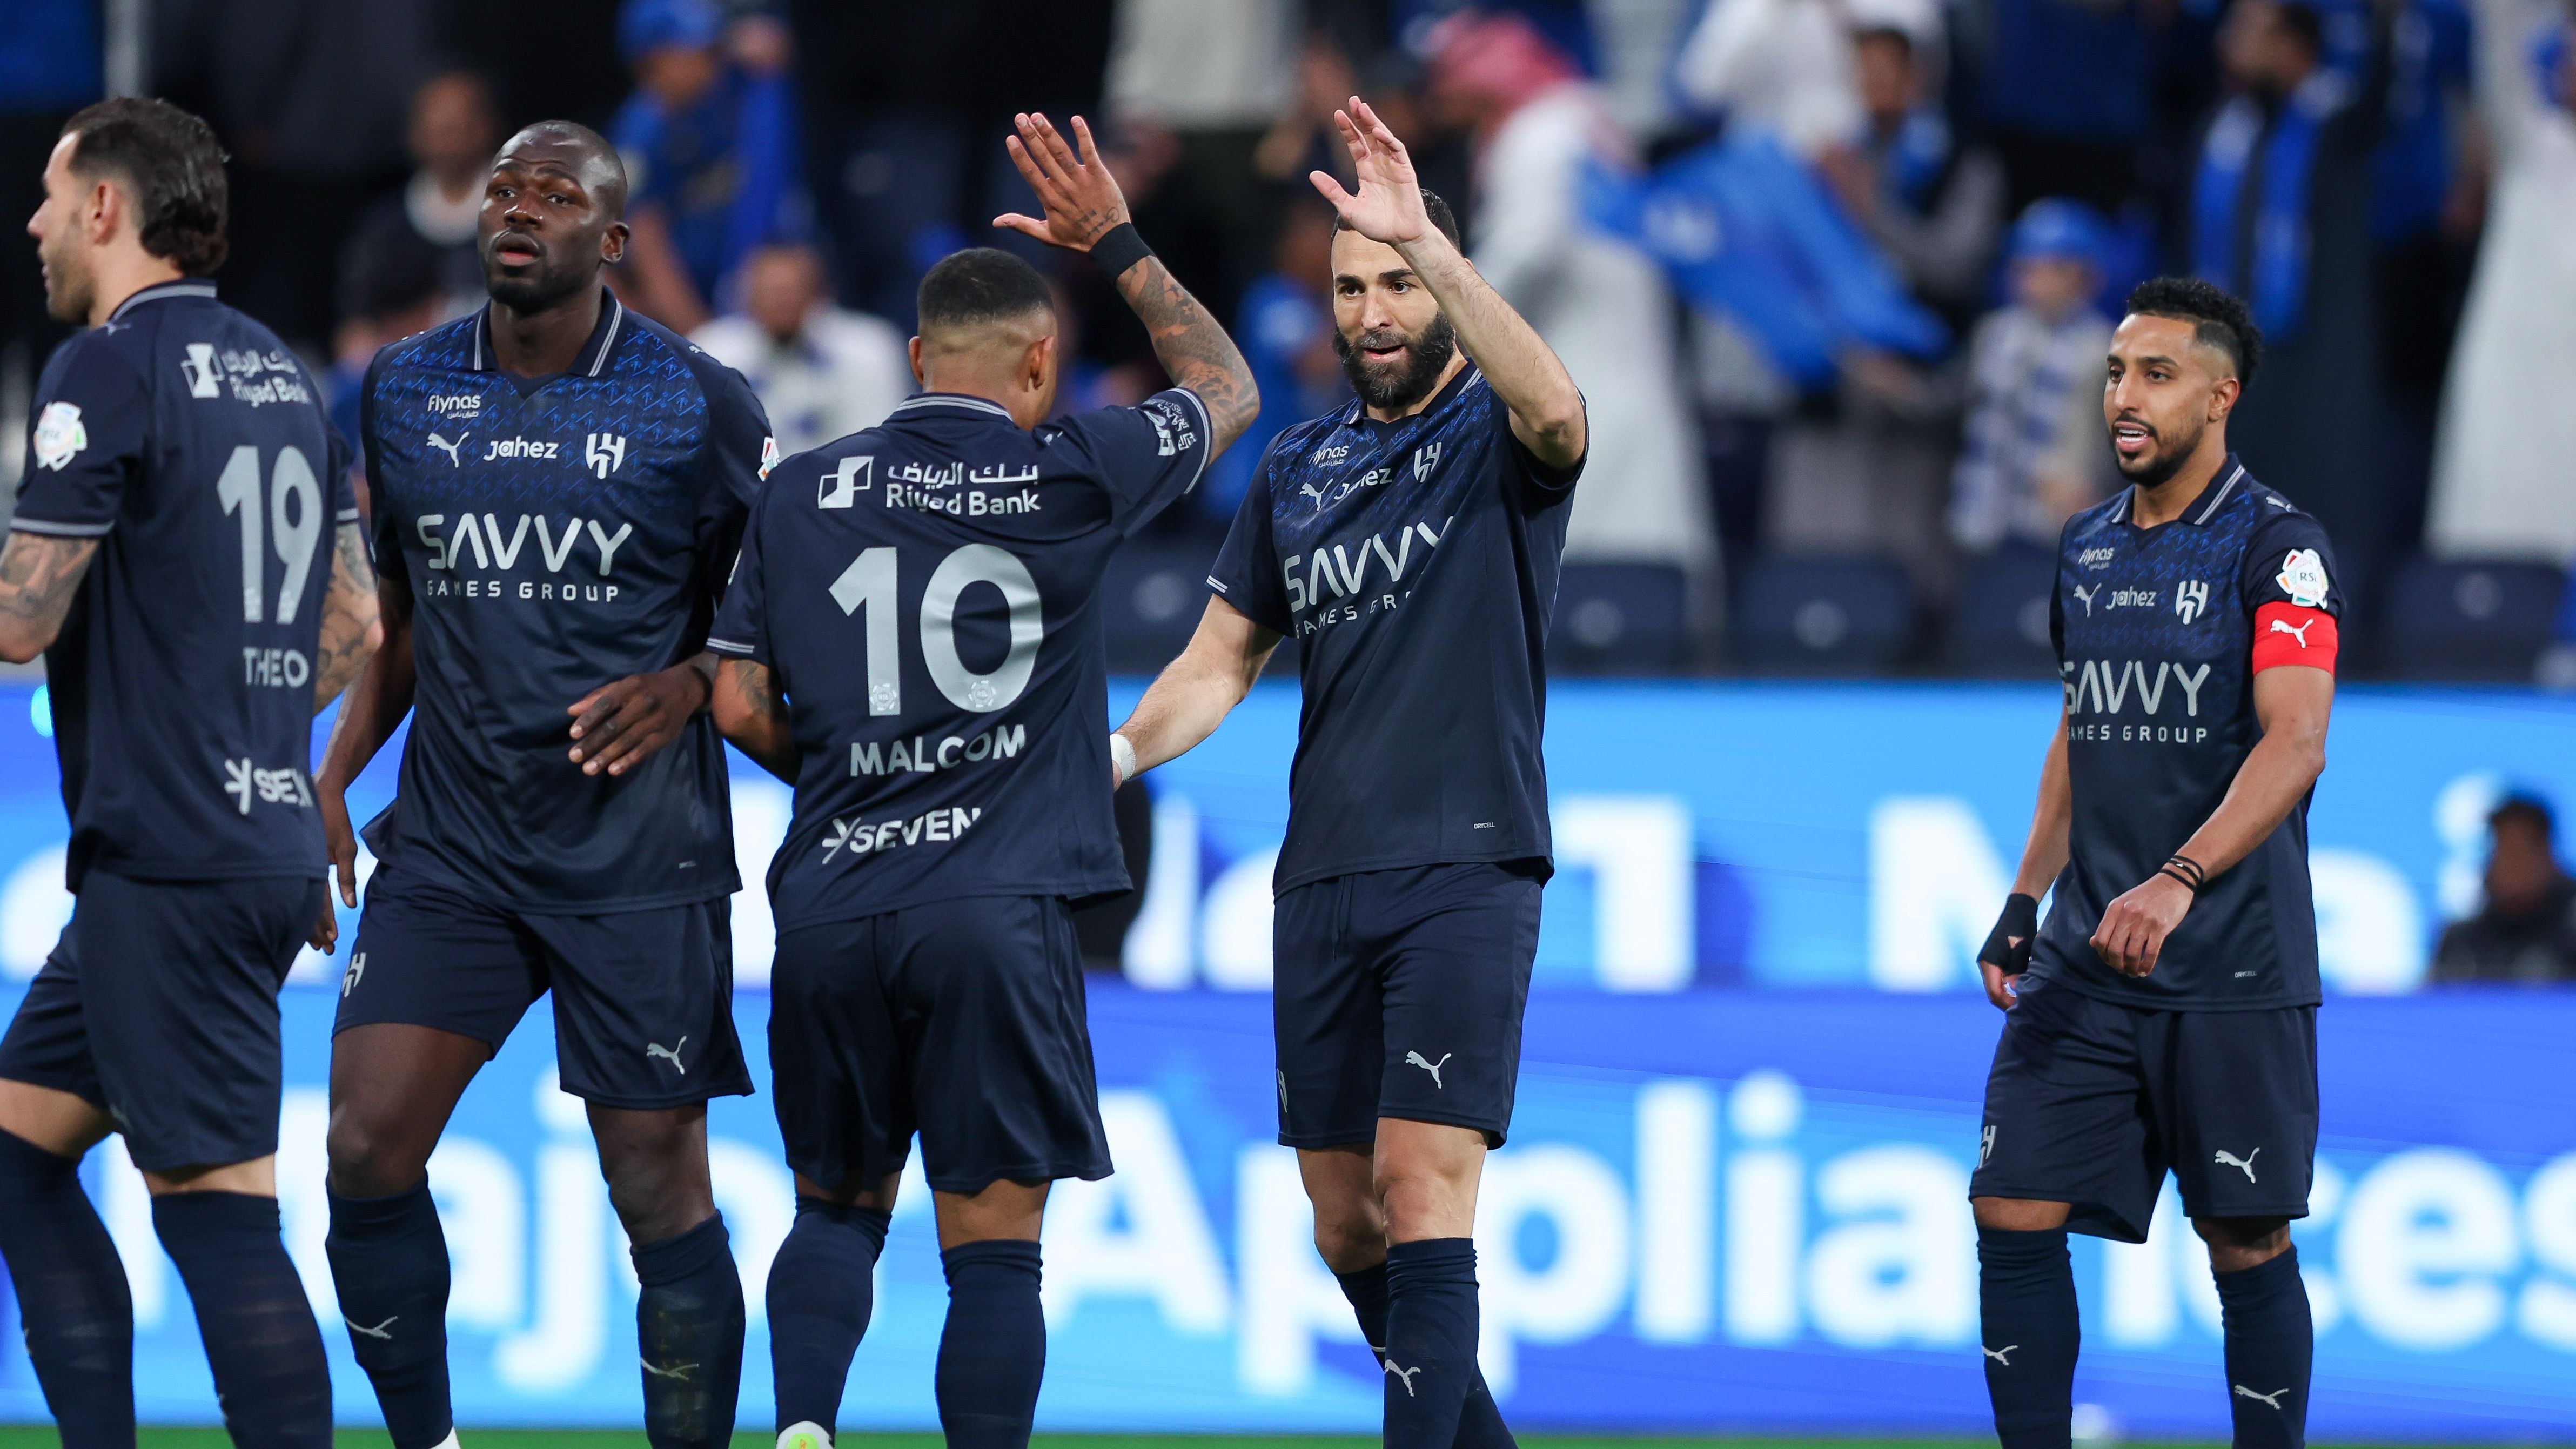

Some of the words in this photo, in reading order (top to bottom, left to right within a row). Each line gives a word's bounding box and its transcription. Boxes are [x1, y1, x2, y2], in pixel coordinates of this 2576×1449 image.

[427, 394, 481, 414] flynas
[887, 461, 963, 489] الرياض
[969, 462, 1039, 485] بنك
[886, 483, 962, 514] Riyad
[969, 489, 1041, 516] Bank
[217, 446, 323, 624] 19
[417, 512, 633, 576] SAVVY
[427, 579, 501, 598] GAMES
[518, 581, 619, 602] GROUP
[828, 543, 1044, 717] 10
[243, 647, 309, 688] THEO
[2060, 660, 2211, 717] SAVVY
[850, 724, 1026, 777] MALCOM
[2123, 725, 2208, 744] GROUP
[849, 807, 982, 854] SEVEN
